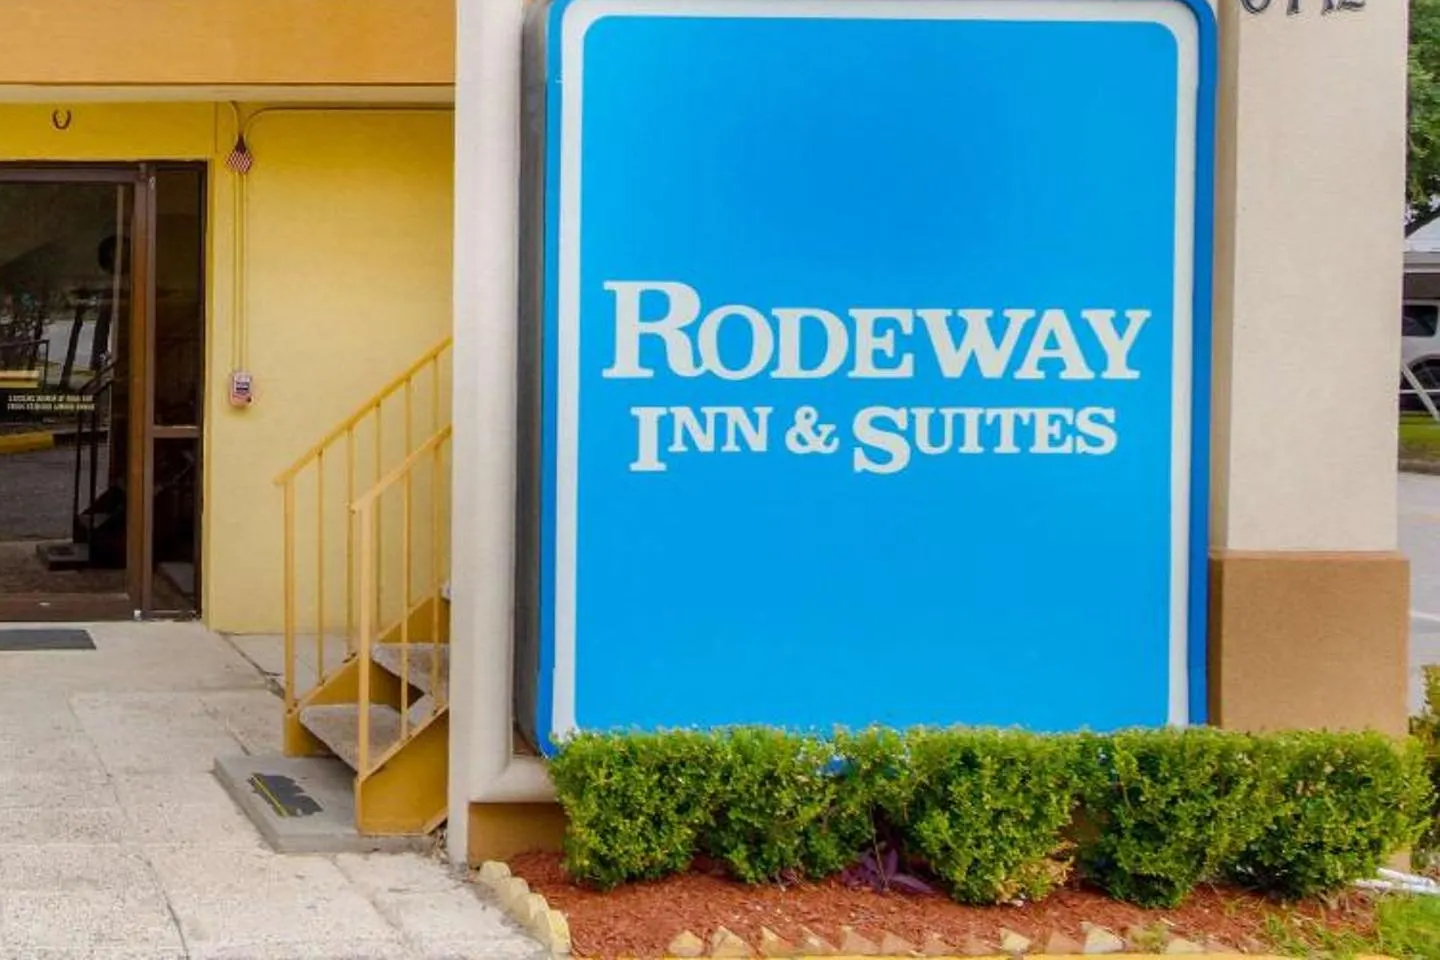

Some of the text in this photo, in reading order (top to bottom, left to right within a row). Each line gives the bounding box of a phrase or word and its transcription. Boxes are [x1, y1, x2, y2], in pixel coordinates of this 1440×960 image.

[602, 280, 1151, 381] RODEWAY
[629, 406, 1118, 474] INN & SUITES
